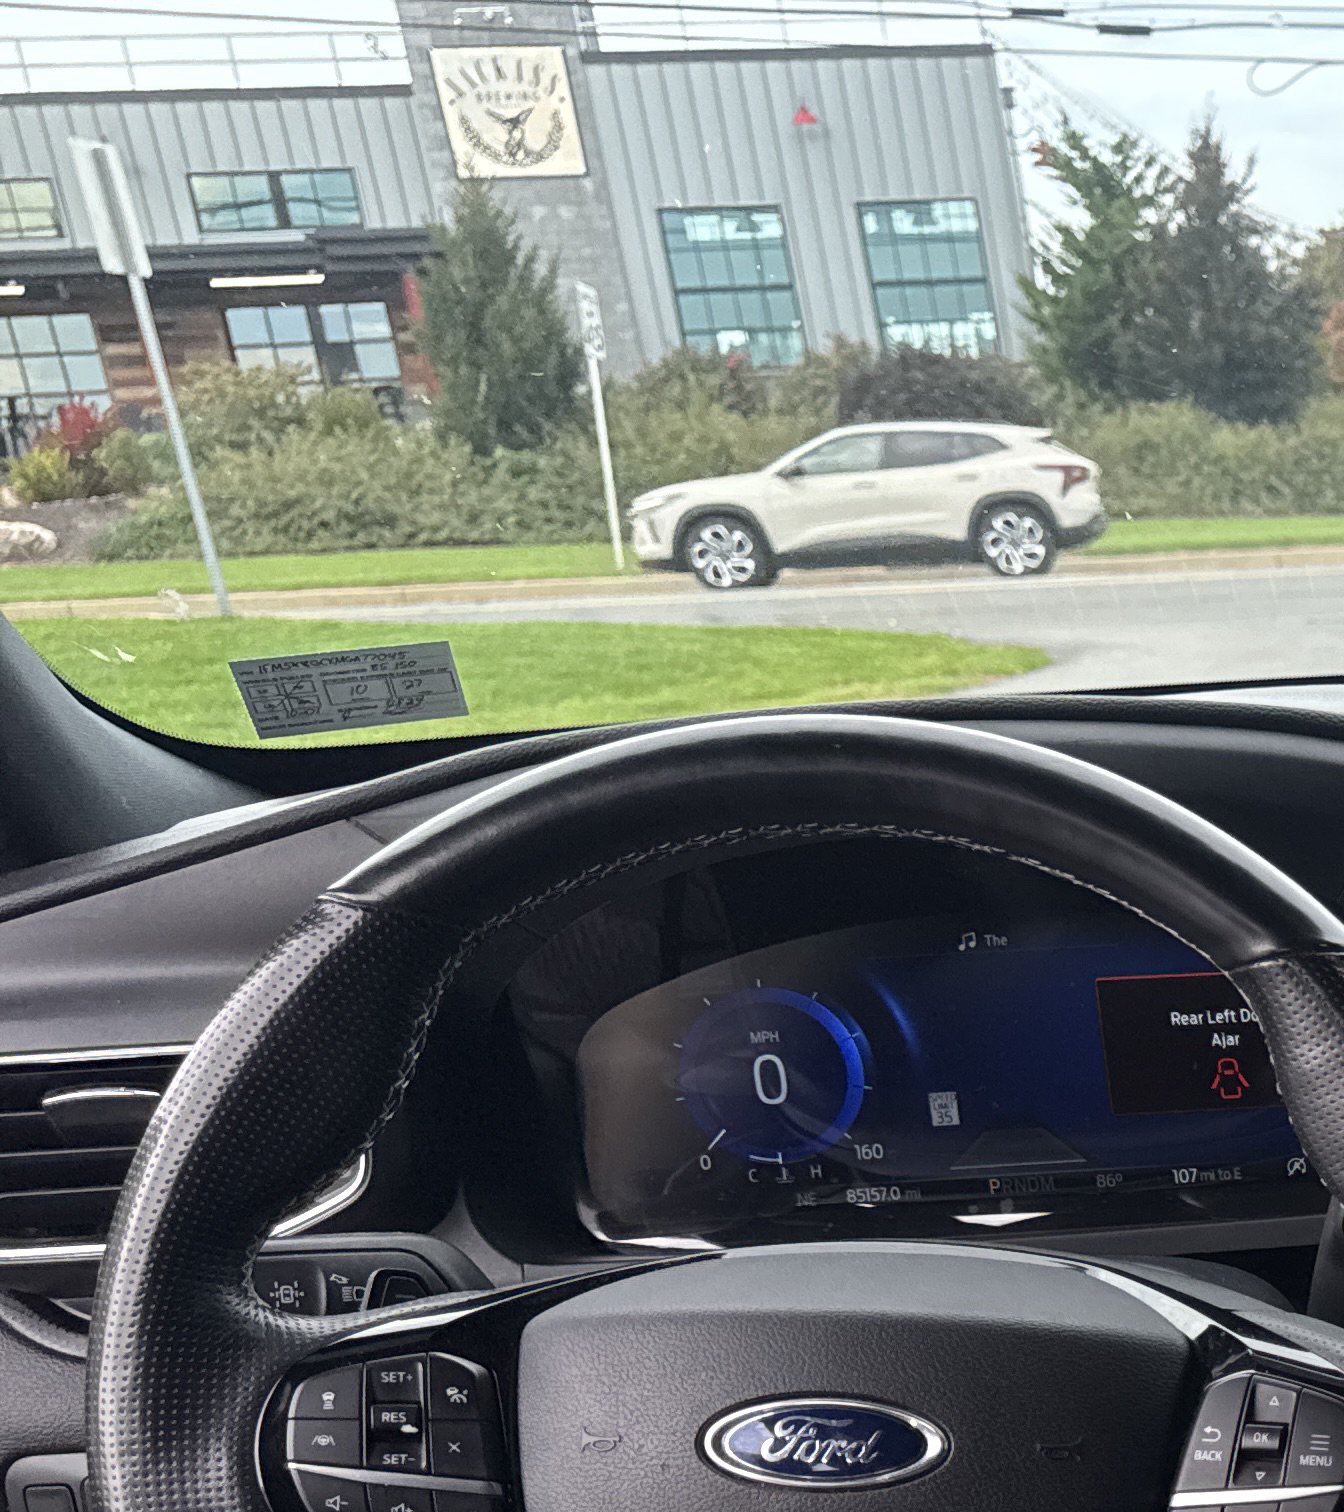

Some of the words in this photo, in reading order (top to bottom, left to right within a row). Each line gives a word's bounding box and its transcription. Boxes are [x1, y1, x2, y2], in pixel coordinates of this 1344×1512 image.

[984, 933, 1008, 947] The
[1171, 1010, 1203, 1026] Rear
[1206, 1008, 1236, 1025] Left
[749, 1030, 780, 1045] MPH
[1211, 1032, 1240, 1049] Ajar
[753, 1054, 788, 1105] 0
[936, 1110, 953, 1124] 35
[854, 1143, 884, 1161] 160
[700, 1154, 712, 1171] 0
[749, 1167, 760, 1183] C
[809, 1164, 823, 1179] H
[1172, 1167, 1198, 1184] 107
[1200, 1167, 1216, 1181] mi
[1219, 1168, 1231, 1181] to
[1233, 1167, 1243, 1181] E
[846, 1185, 901, 1204] 85157.0
[904, 1188, 922, 1200] mi
[380, 1371, 414, 1383] SET+
[381, 1411, 407, 1423] RES
[760, 1415, 884, 1465] Ford
[1253, 1432, 1269, 1443] OK
[382, 1453, 416, 1465] SET-
[1193, 1450, 1222, 1462] BACK
[1299, 1454, 1333, 1467] MENU
